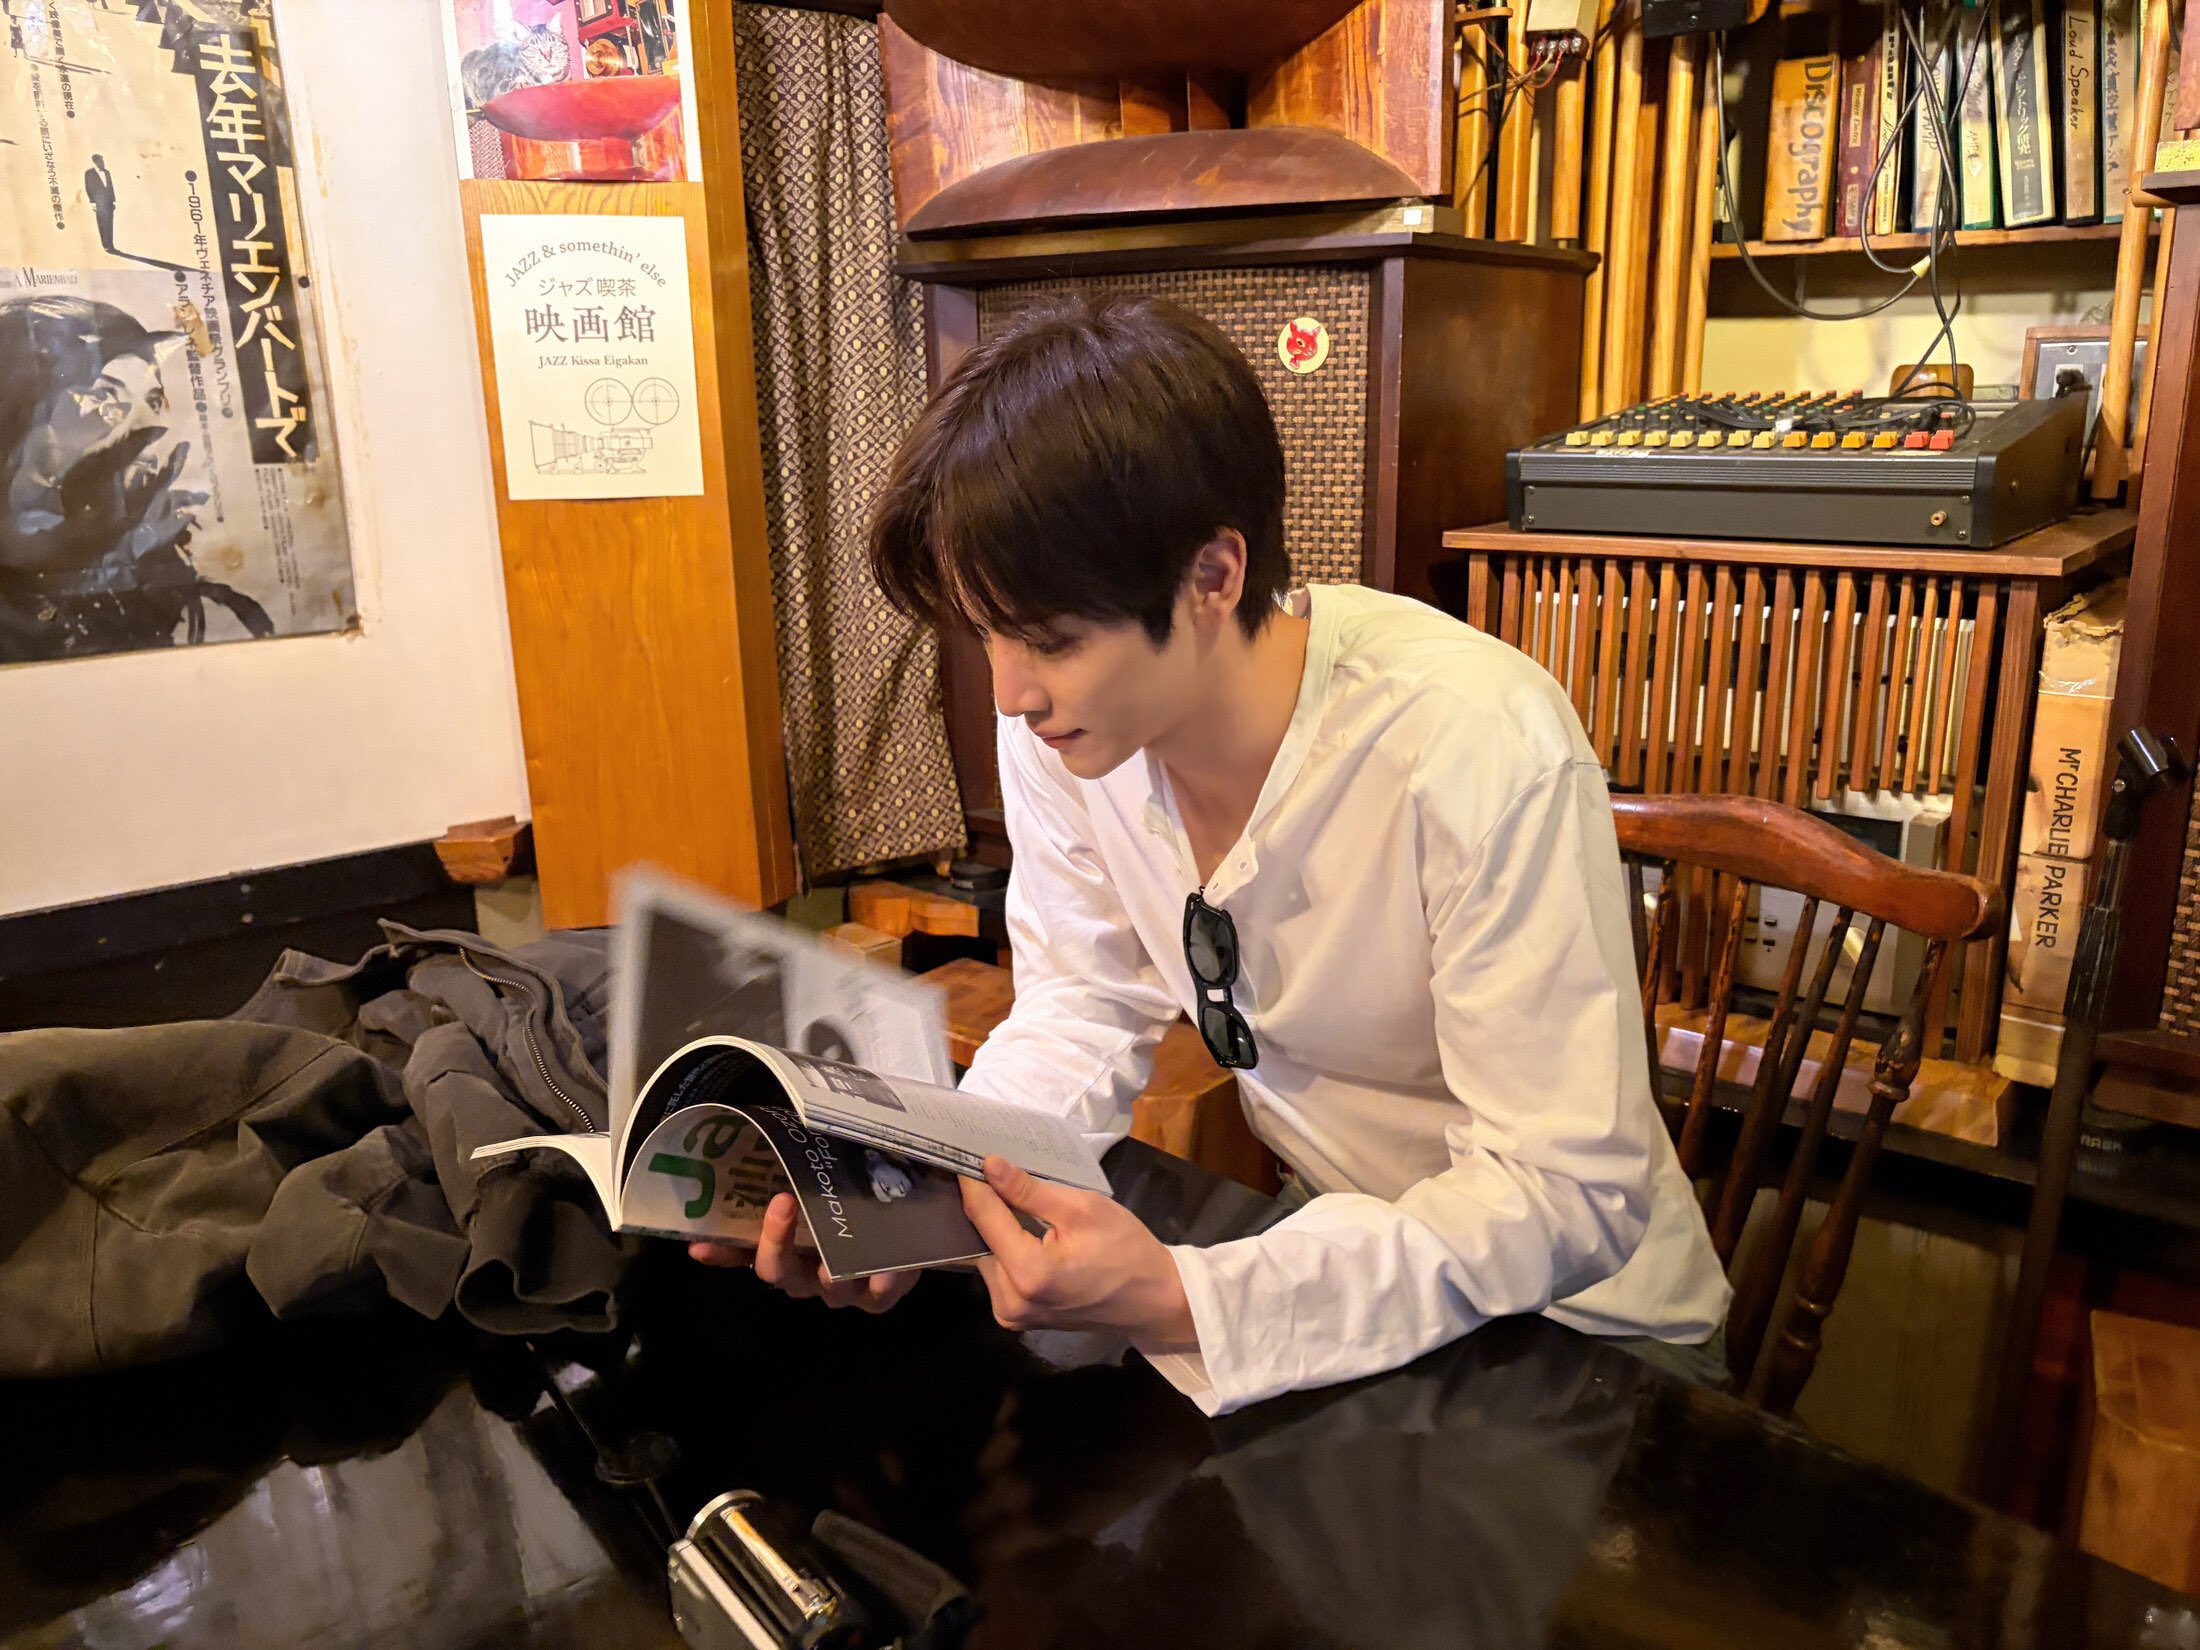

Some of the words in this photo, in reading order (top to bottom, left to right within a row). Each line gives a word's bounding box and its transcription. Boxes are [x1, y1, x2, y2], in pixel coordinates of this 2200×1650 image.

[2069, 15, 2089, 57] Loud
[2070, 64, 2090, 130] Speaker
[199, 34, 306, 457] 去年マリエンバートで
[504, 250, 541, 289] JAZZ
[542, 243, 556, 259] &
[639, 262, 667, 289] else
[538, 278, 636, 298] ジャズ喫茶
[525, 303, 656, 345] 映画館
[538, 354, 568, 368] JAZZ
[570, 354, 601, 367] Kissa
[603, 354, 649, 369] Eigakan
[2047, 770, 2077, 857] CHARLIE
[2034, 860, 2067, 950] PARKER
[806, 1150, 854, 1238] Makoto
